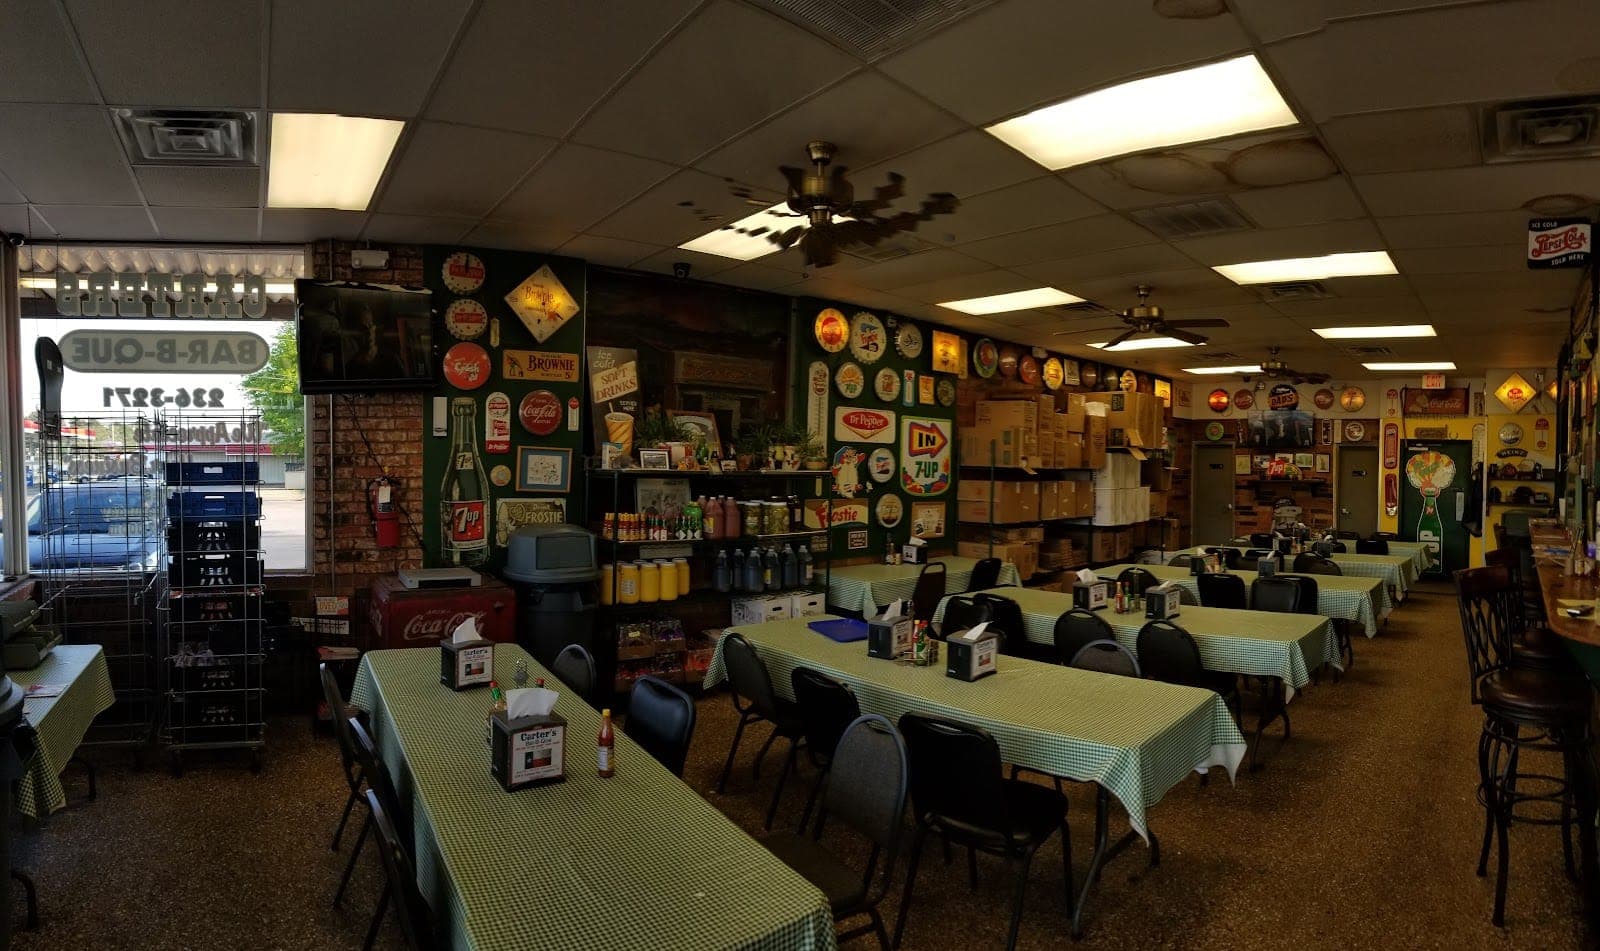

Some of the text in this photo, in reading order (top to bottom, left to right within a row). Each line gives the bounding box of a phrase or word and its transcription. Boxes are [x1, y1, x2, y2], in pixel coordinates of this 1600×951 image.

[527, 355, 576, 372] BROWNIE
[596, 375, 636, 400] DRINKS
[849, 414, 884, 430] Dr Pepper
[917, 433, 935, 447] IN
[525, 511, 561, 524] FROSTIE
[520, 729, 556, 741] Carter's
